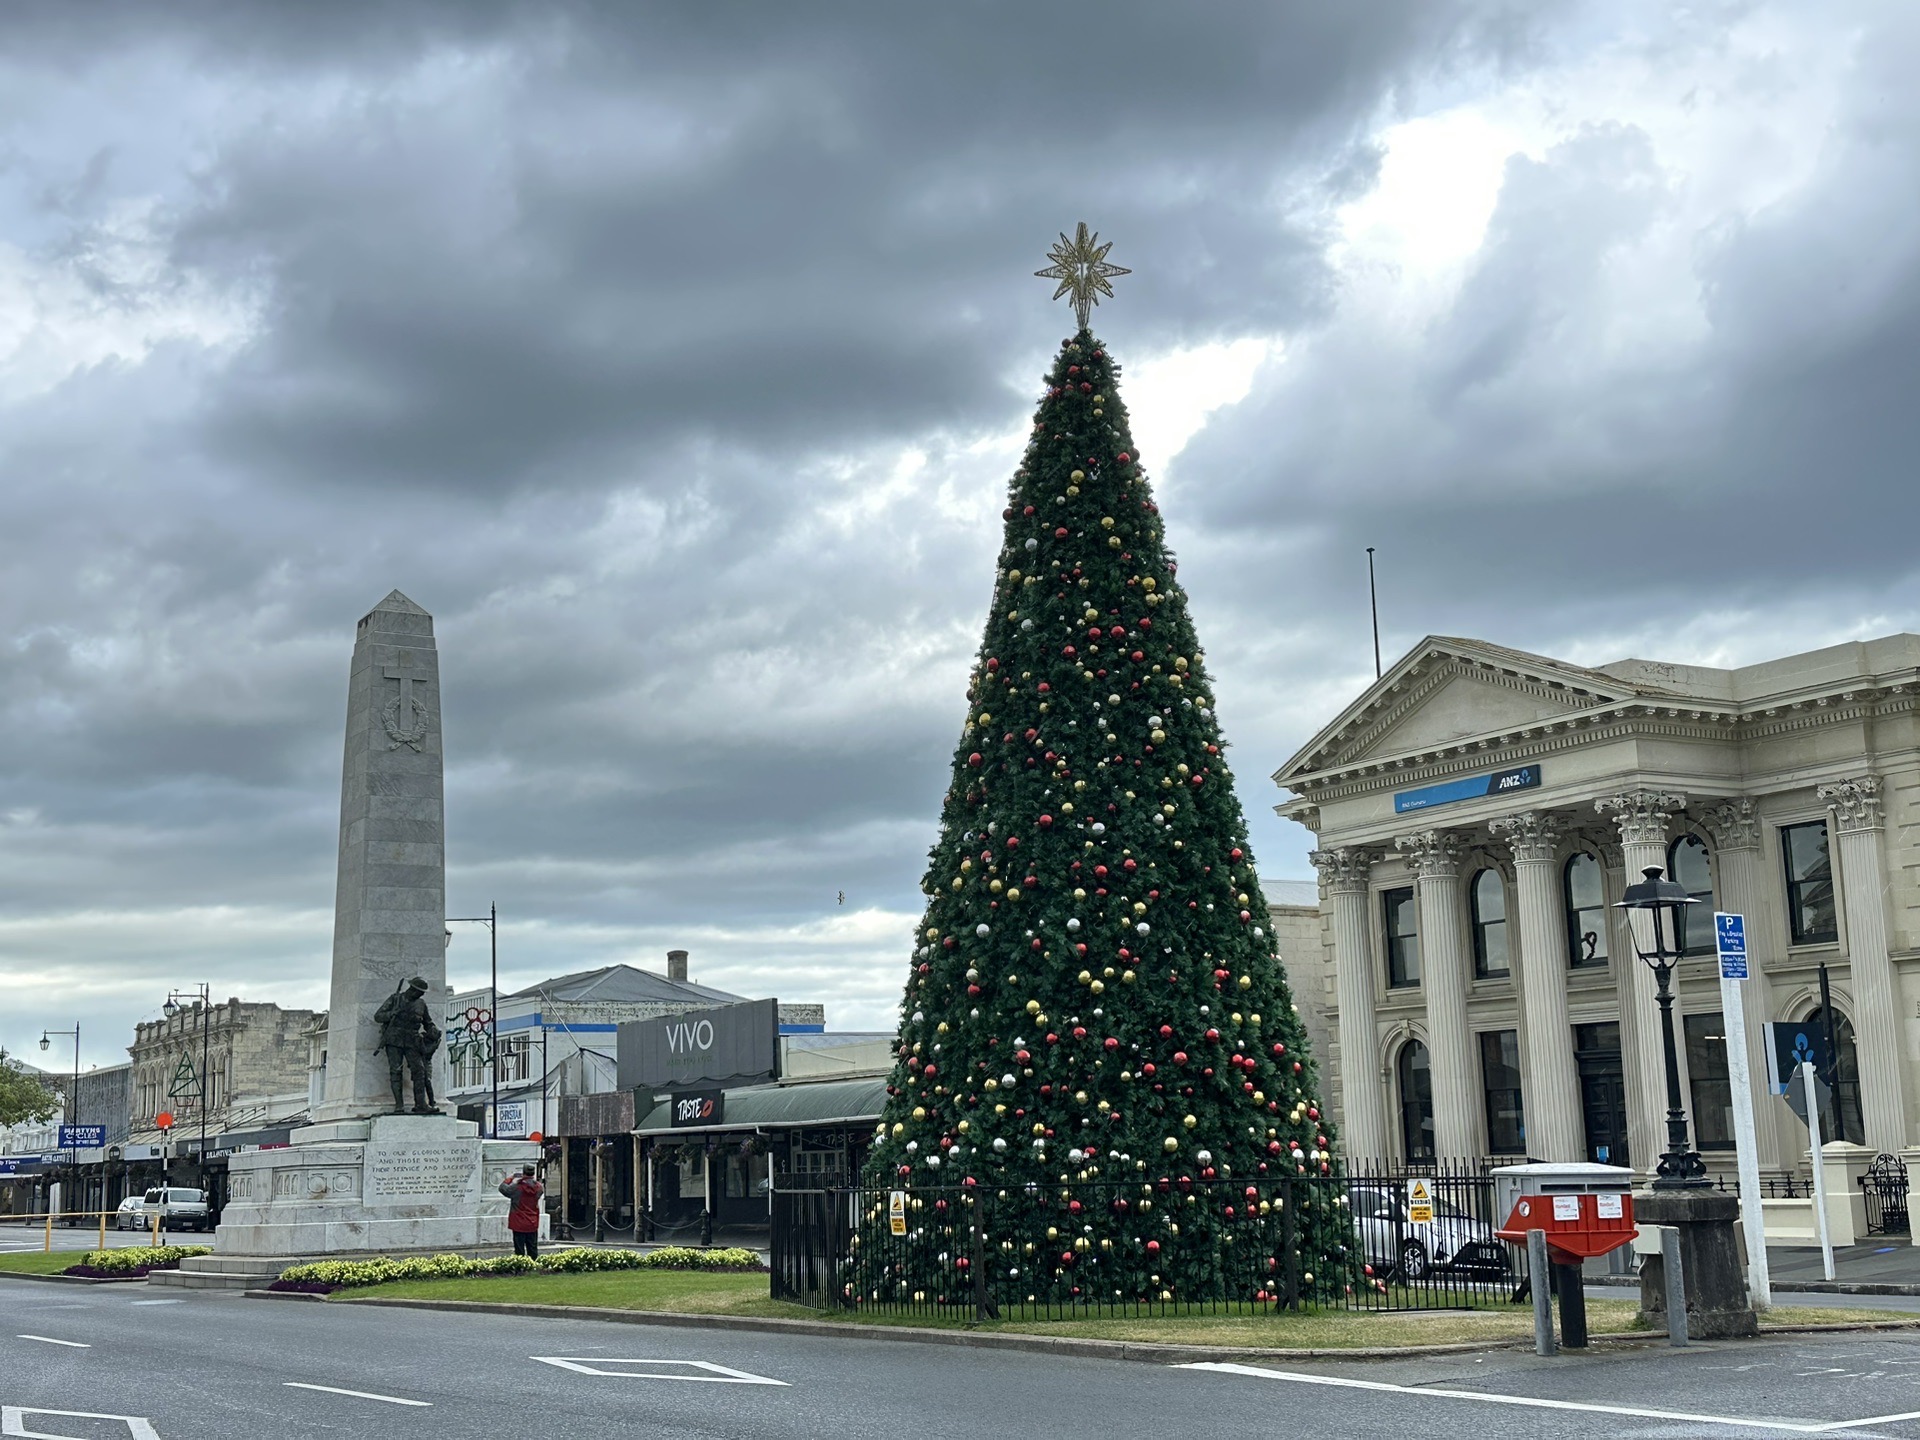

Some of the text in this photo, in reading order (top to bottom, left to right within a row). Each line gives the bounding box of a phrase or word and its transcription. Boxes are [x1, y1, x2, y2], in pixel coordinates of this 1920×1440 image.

[1498, 775, 1520, 789] ANZ
[1725, 917, 1734, 929] P
[666, 1019, 714, 1053] VIVO
[677, 1097, 702, 1121] TASTE
[412, 1149, 446, 1157] GLORIOUS
